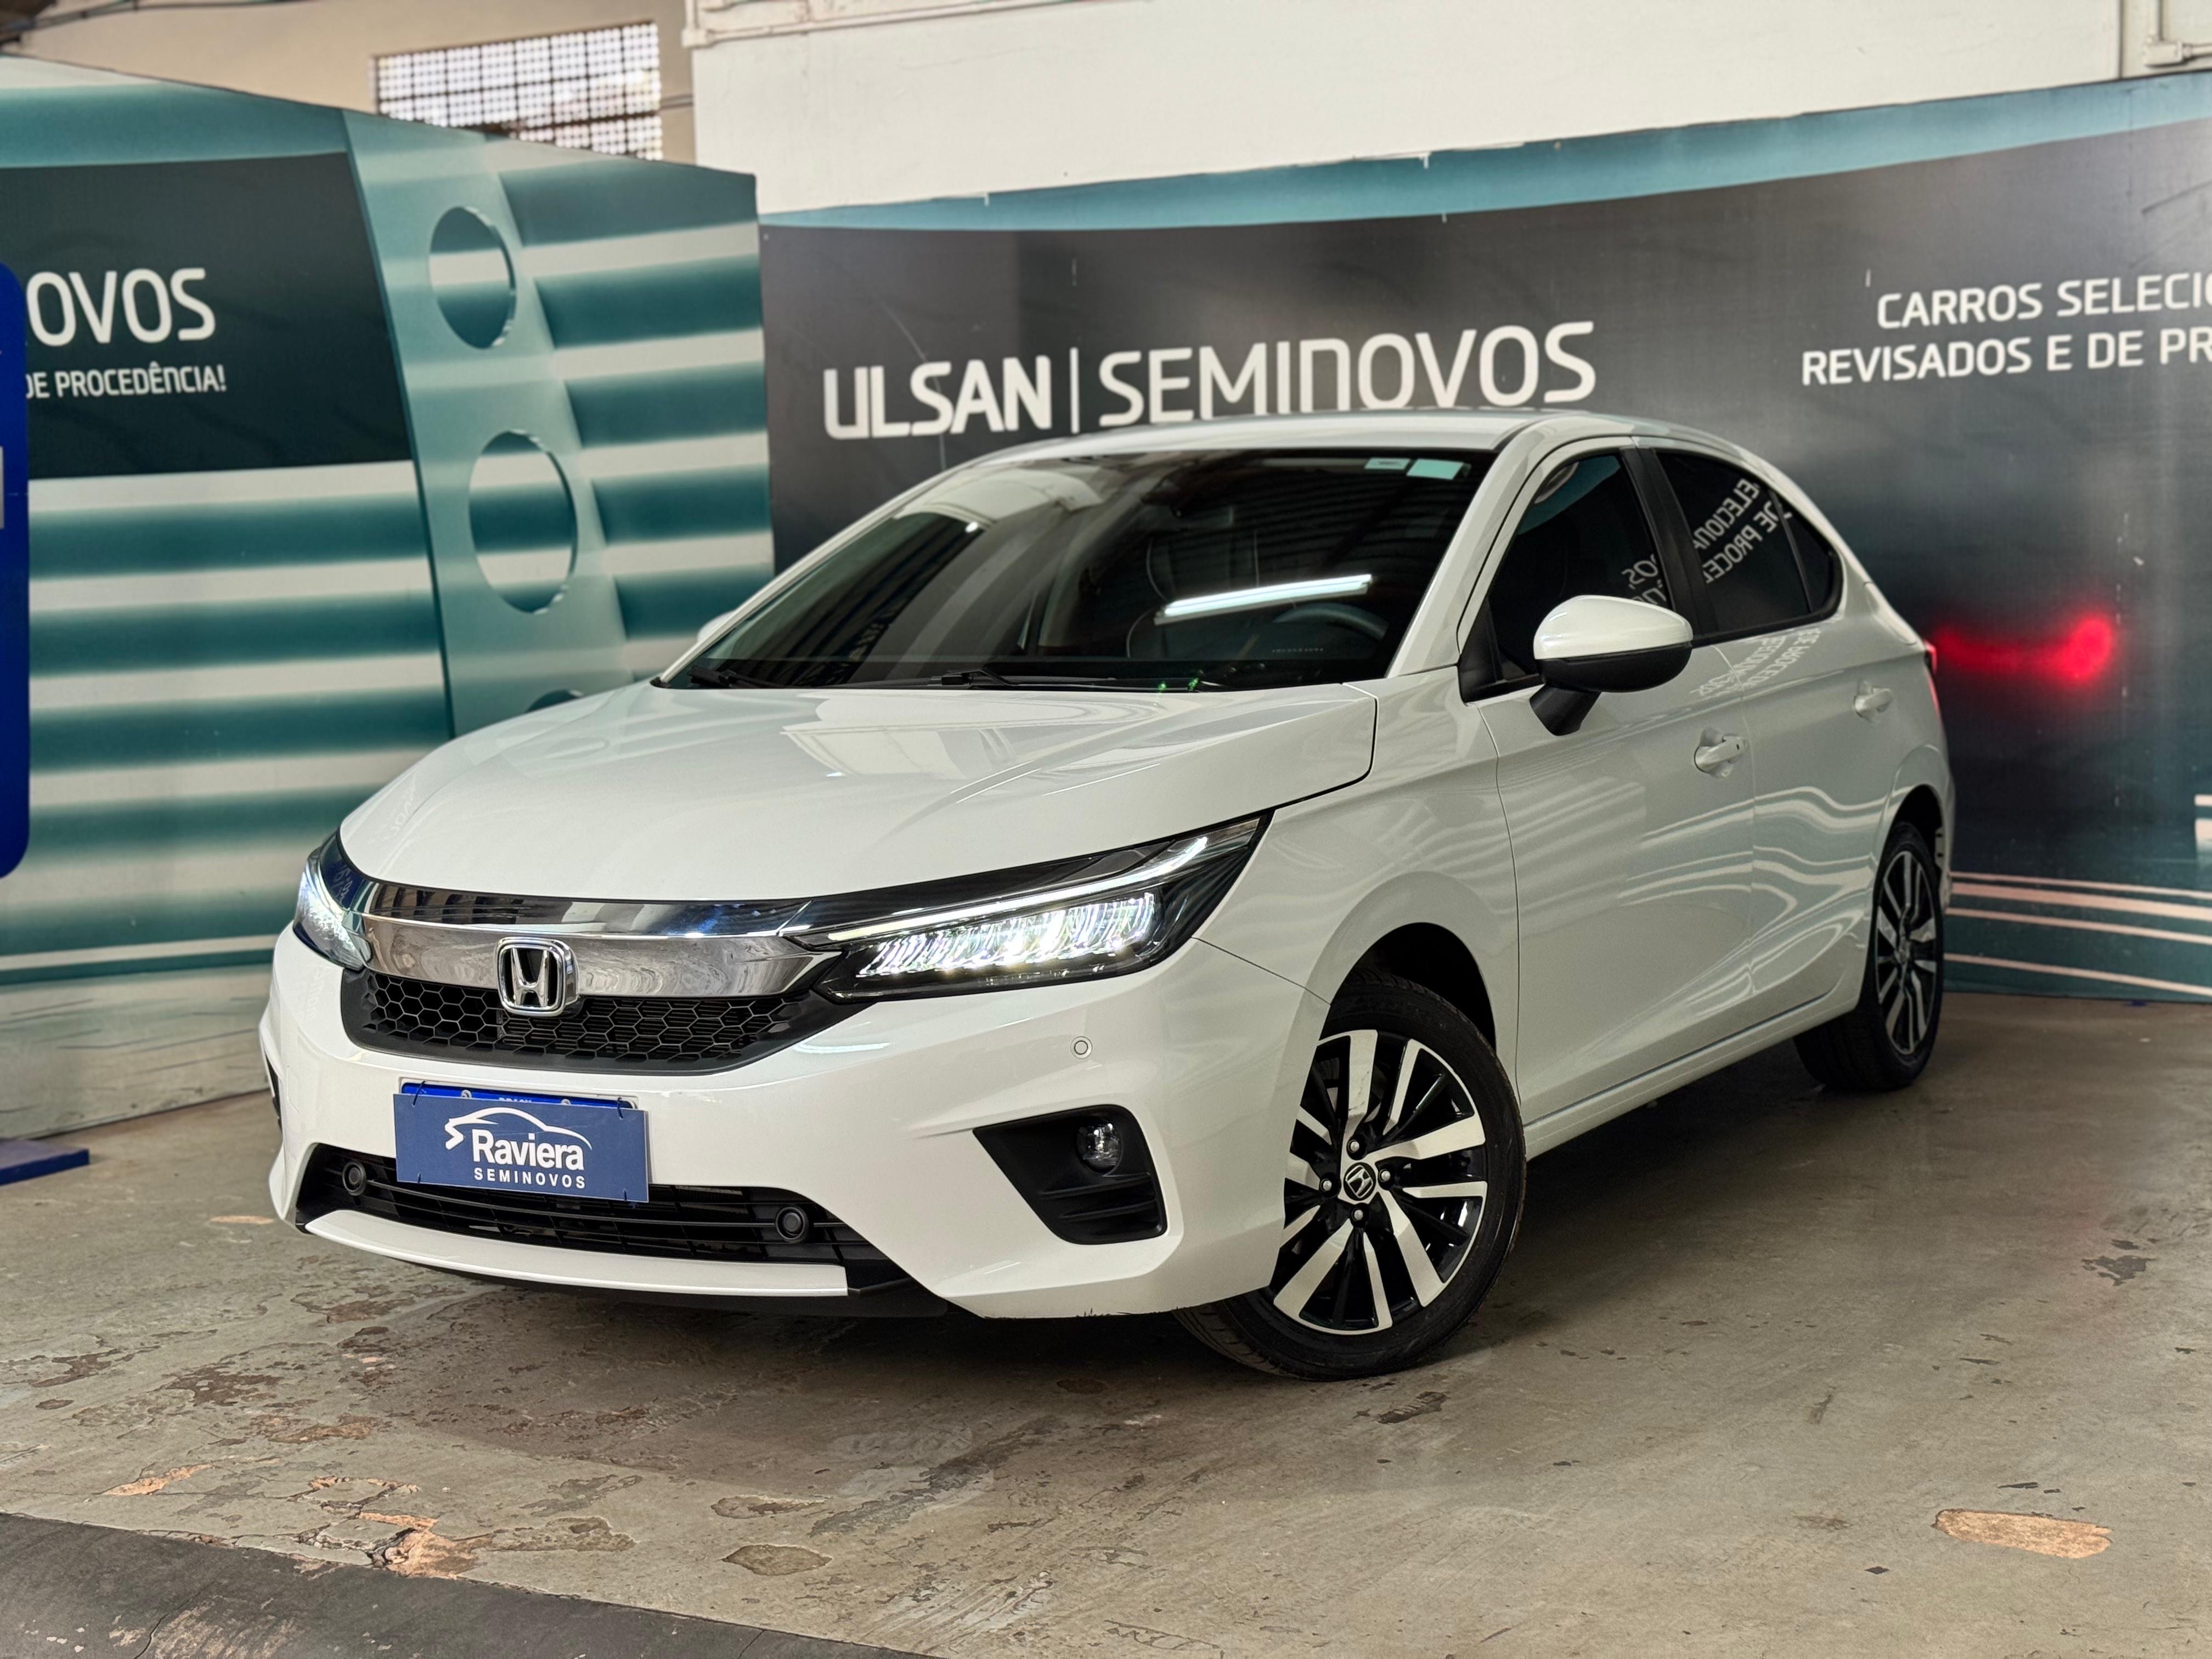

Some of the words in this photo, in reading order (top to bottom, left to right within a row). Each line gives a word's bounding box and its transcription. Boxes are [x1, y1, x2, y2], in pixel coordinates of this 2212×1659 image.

[26, 268, 216, 347] OVOS
[1877, 283, 2043, 329] CARROS
[54, 360, 227, 398] PROCEDÊNCIA!
[823, 355, 1052, 439] ULSAN
[1098, 321, 1596, 427] SEMINOVOS
[1802, 337, 2032, 386] REVISADOS
[2047, 334, 2073, 371] E
[2087, 330, 2144, 369] DE
[471, 1128, 585, 1171] Raviera
[473, 1167, 586, 1190] SEMINOVOS
